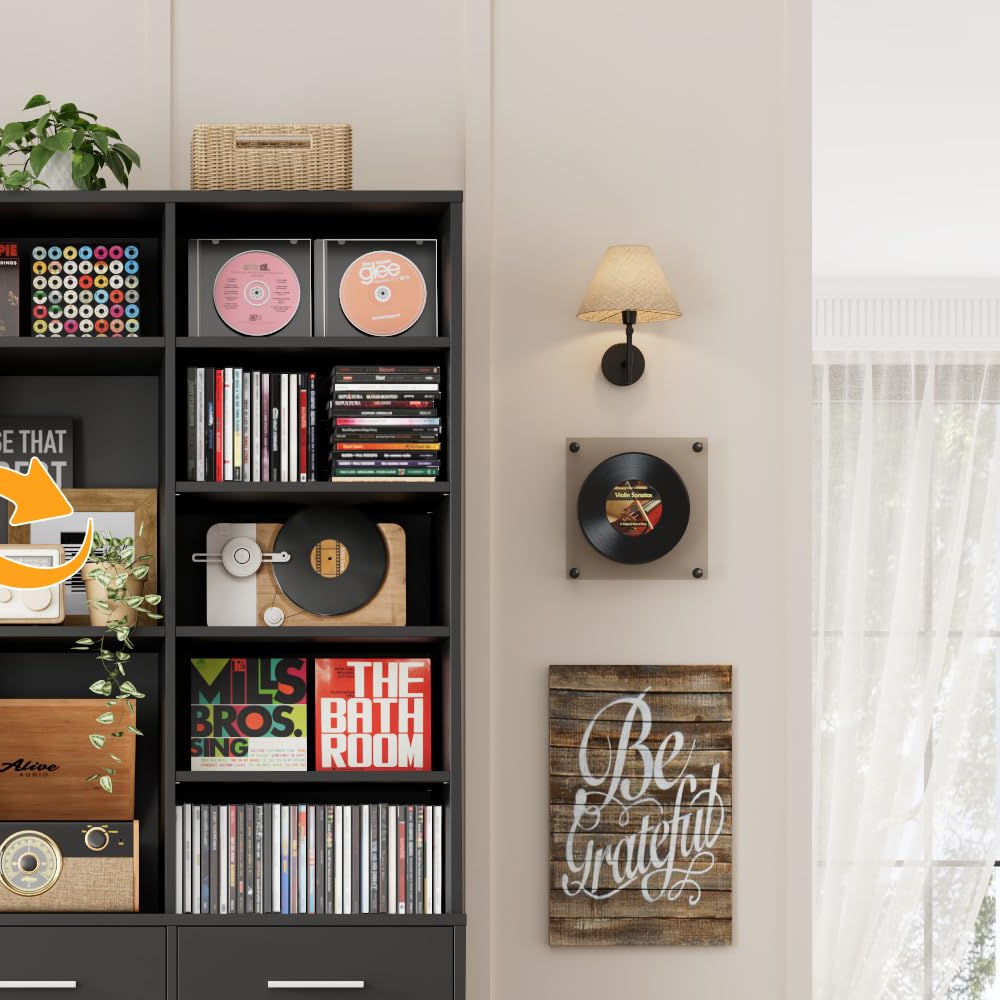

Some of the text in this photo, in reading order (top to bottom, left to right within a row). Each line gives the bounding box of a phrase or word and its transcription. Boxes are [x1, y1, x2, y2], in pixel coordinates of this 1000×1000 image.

[359, 261, 401, 285] glee
[19, 429, 67, 454] THAT
[346, 661, 424, 698] THE
[191, 706, 303, 737] BROS.
[320, 698, 424, 733] BATH
[191, 738, 248, 757] SING
[321, 733, 424, 768] ROOM
[579, 686, 696, 804] Be
[561, 763, 725, 906] Grateful
